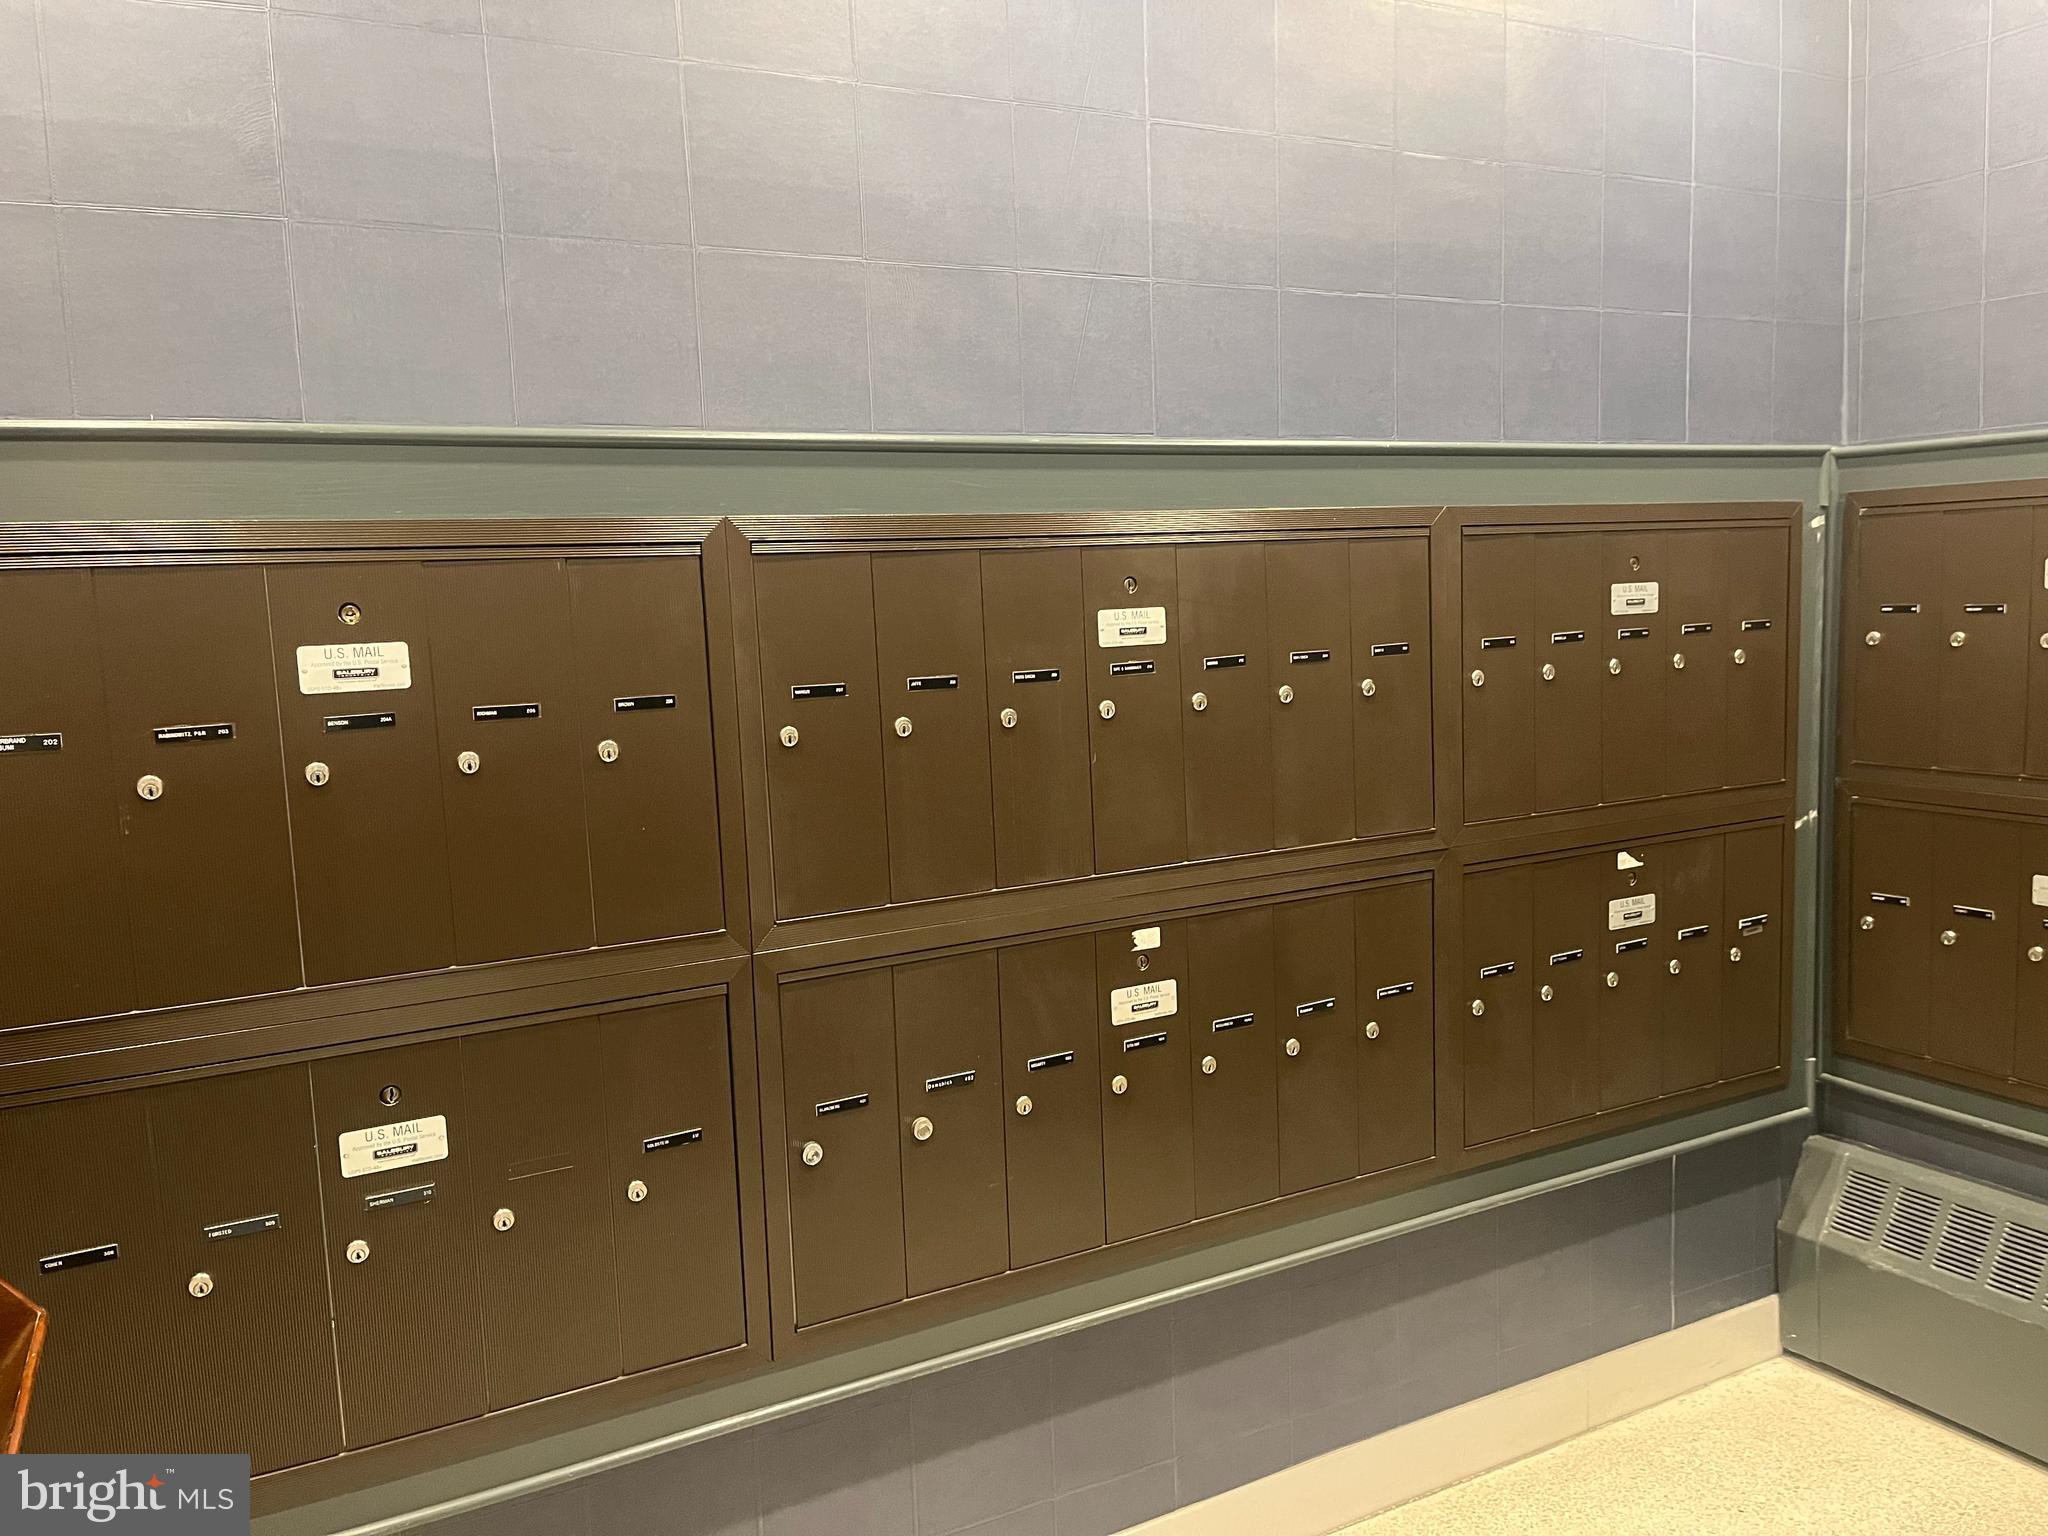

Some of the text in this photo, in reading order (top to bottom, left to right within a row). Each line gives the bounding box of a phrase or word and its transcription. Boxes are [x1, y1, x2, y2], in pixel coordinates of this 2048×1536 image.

[1131, 609, 1151, 620] MAIL
[323, 645, 385, 660] U.S. MAIL
[42, 738, 59, 746] 202
[1143, 983, 1163, 995] MAIL
[364, 1122, 423, 1143] U.S. MAIL
[369, 1197, 394, 1207] SHERMAN
